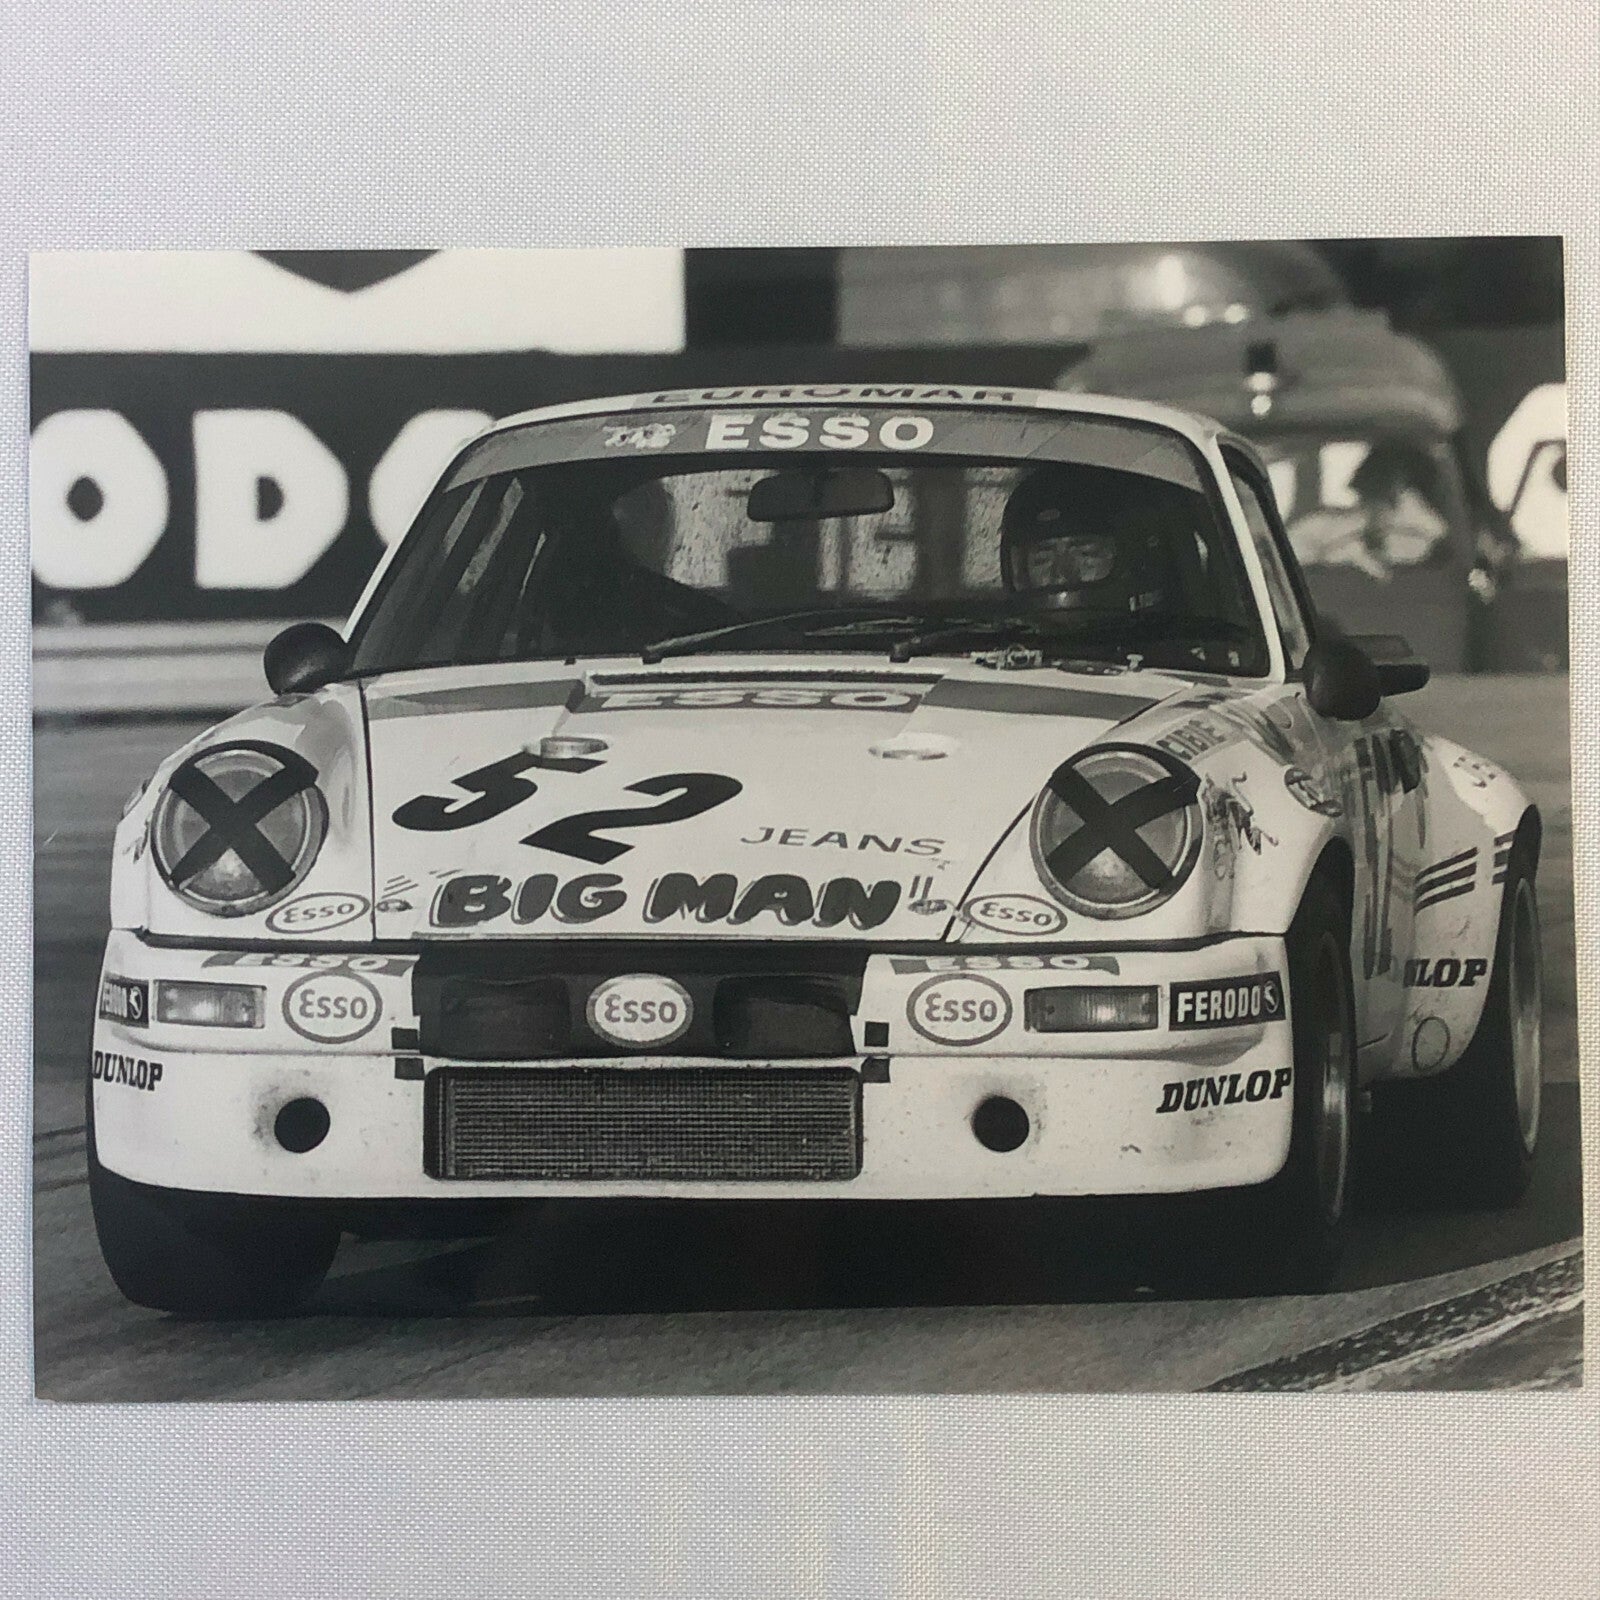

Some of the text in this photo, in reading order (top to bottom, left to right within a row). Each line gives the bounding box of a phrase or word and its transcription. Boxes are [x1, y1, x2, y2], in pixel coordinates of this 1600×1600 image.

[705, 413, 934, 450] ESSO
[601, 690, 911, 708] ESSO
[392, 750, 743, 864] 52
[741, 827, 945, 856] JEANS
[429, 872, 902, 930] BIG MAN
[235, 952, 389, 971] ESSO
[926, 955, 1090, 970] ESSO
[1177, 985, 1261, 1023] FERODO
[93, 1050, 164, 1092] DUNLOP
[1156, 1067, 1292, 1114] DUNLOP
